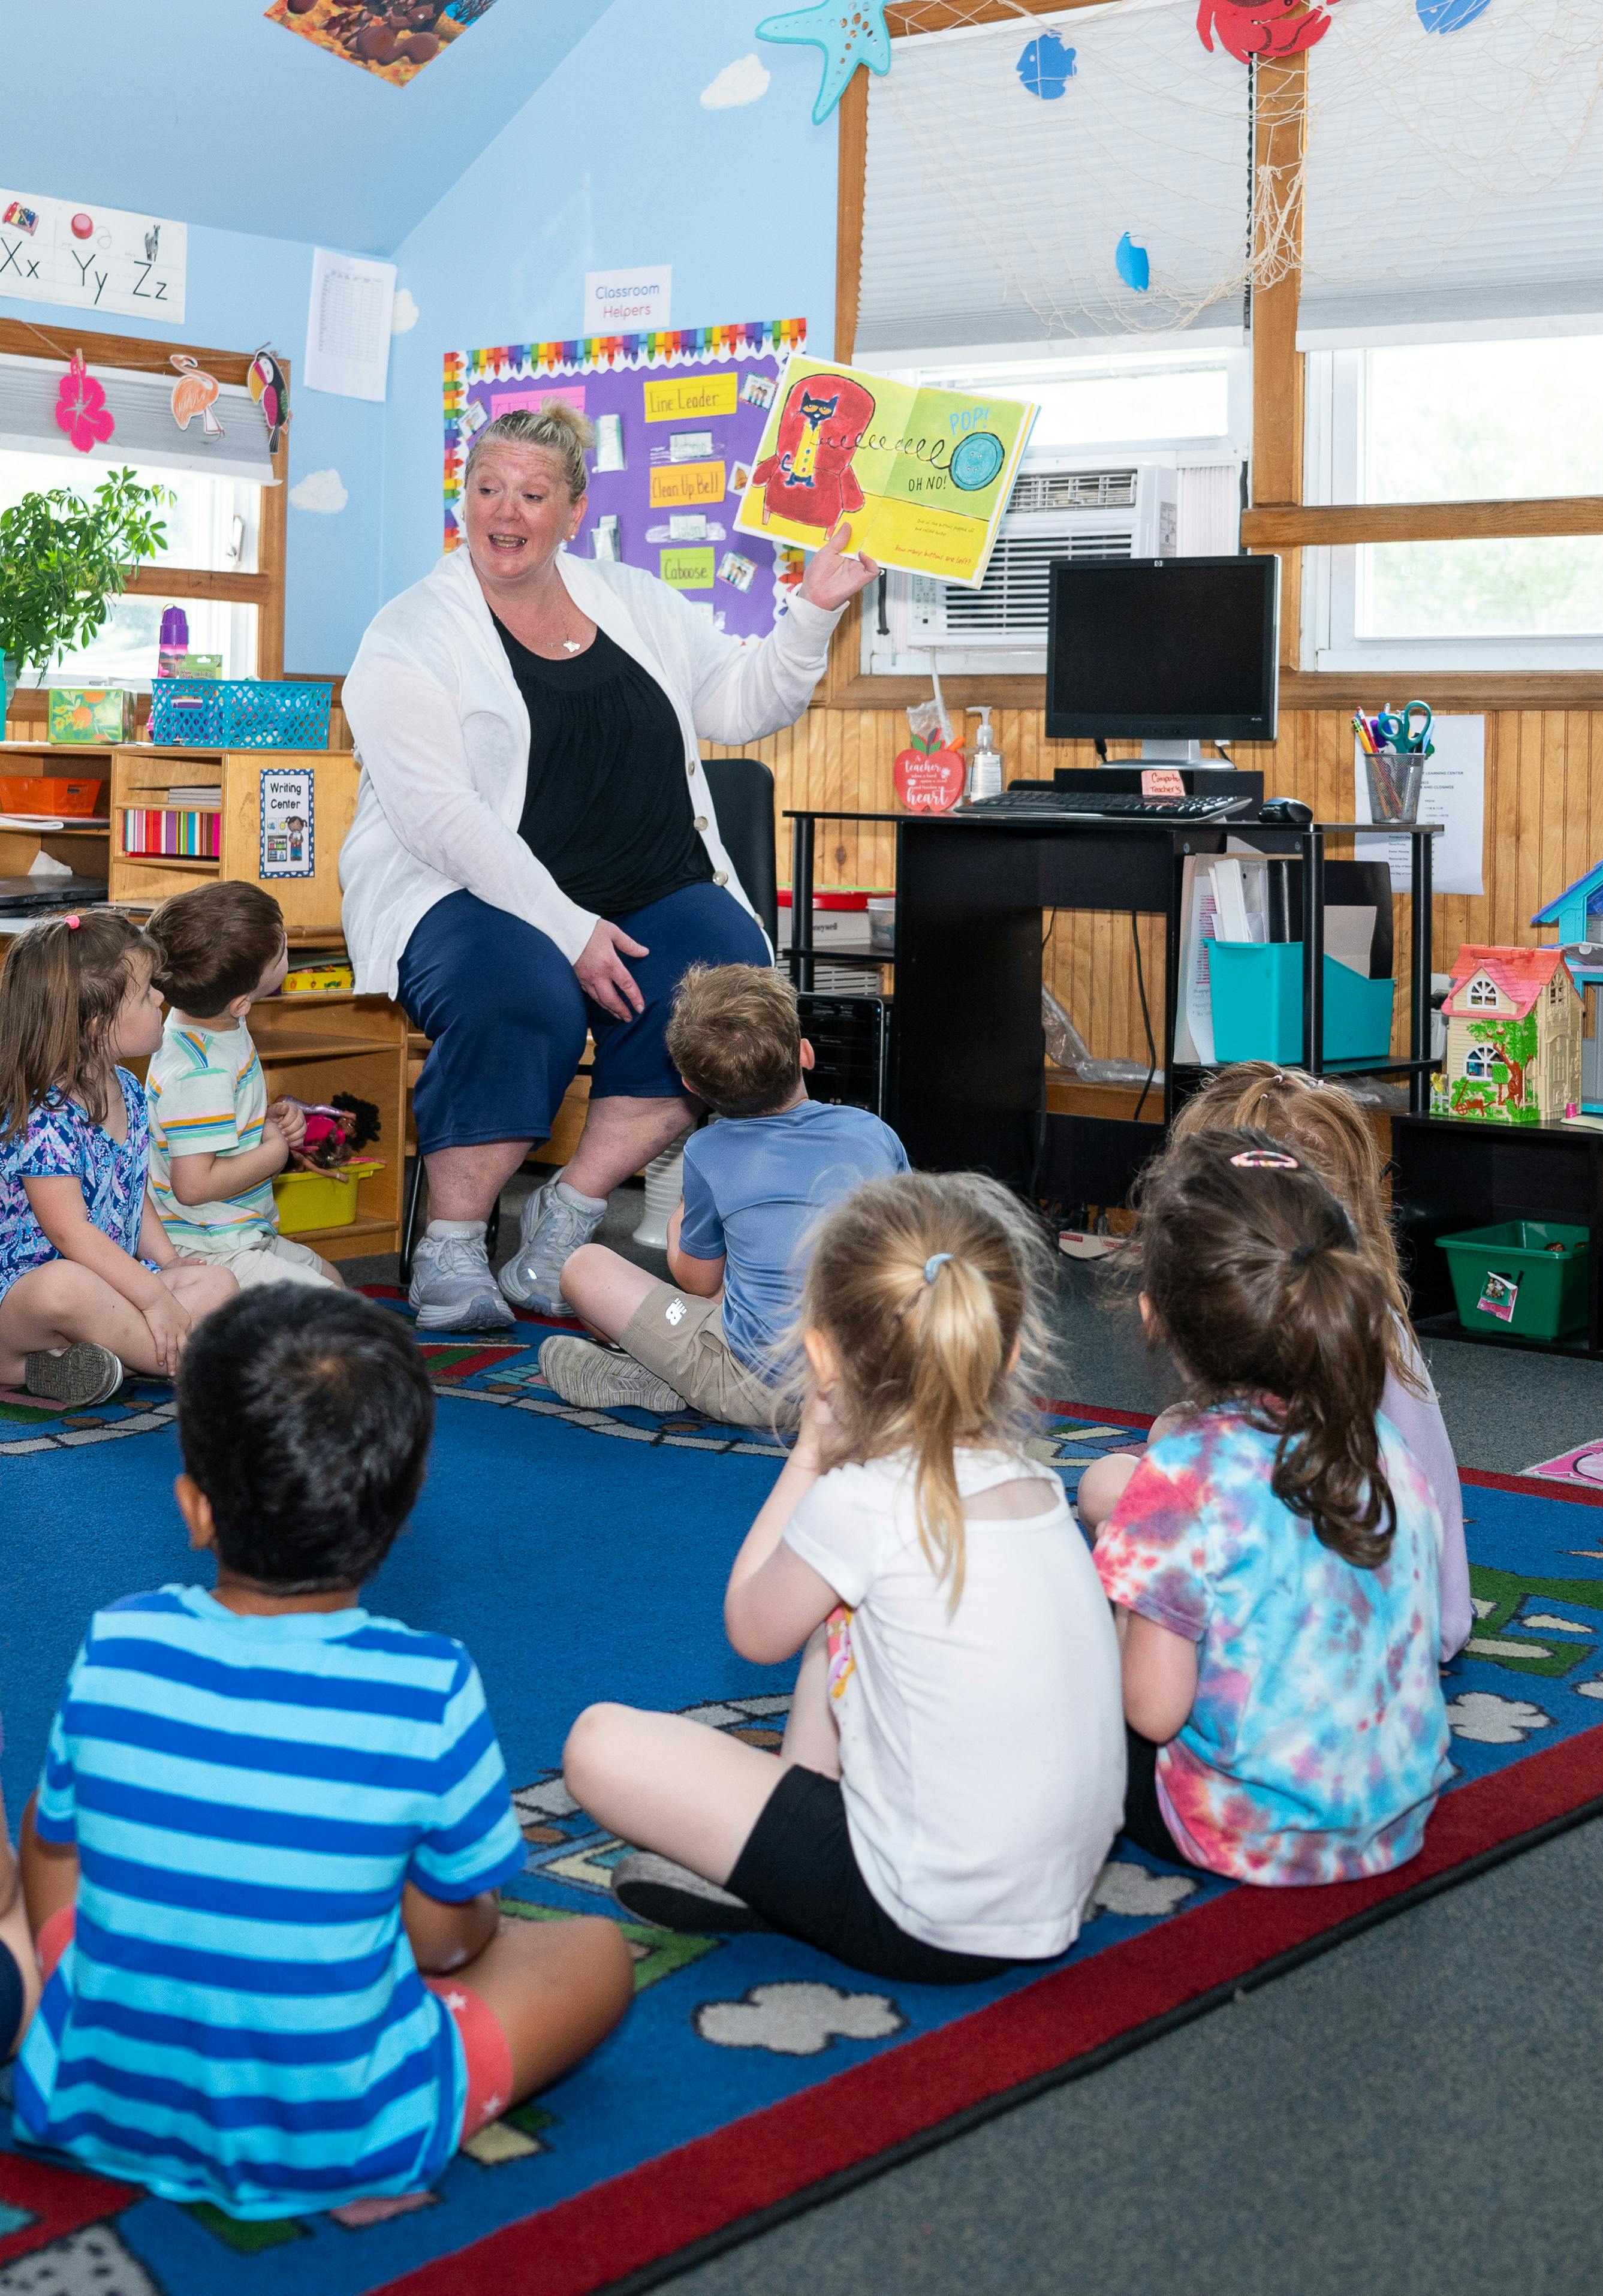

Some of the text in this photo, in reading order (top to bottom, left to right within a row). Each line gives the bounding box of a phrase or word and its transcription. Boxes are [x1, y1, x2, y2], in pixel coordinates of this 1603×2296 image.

[71, 250, 108, 305] Yy
[133, 261, 168, 300] Zz
[595, 285, 659, 299] Classroom
[603, 305, 651, 320] Helpers
[650, 385, 720, 413] Line Leader
[949, 406, 989, 435] POP!
[652, 472, 719, 500] Clean Up Bell
[909, 475, 947, 492] OH NO!
[907, 548, 922, 556] many
[924, 550, 943, 560] buttons
[956, 556, 971, 565] left?
[664, 558, 708, 580] Caboose
[905, 760, 941, 773] teacher
[270, 782, 302, 796] Writing
[906, 786, 956, 805] heart
[271, 799, 301, 809] Center
